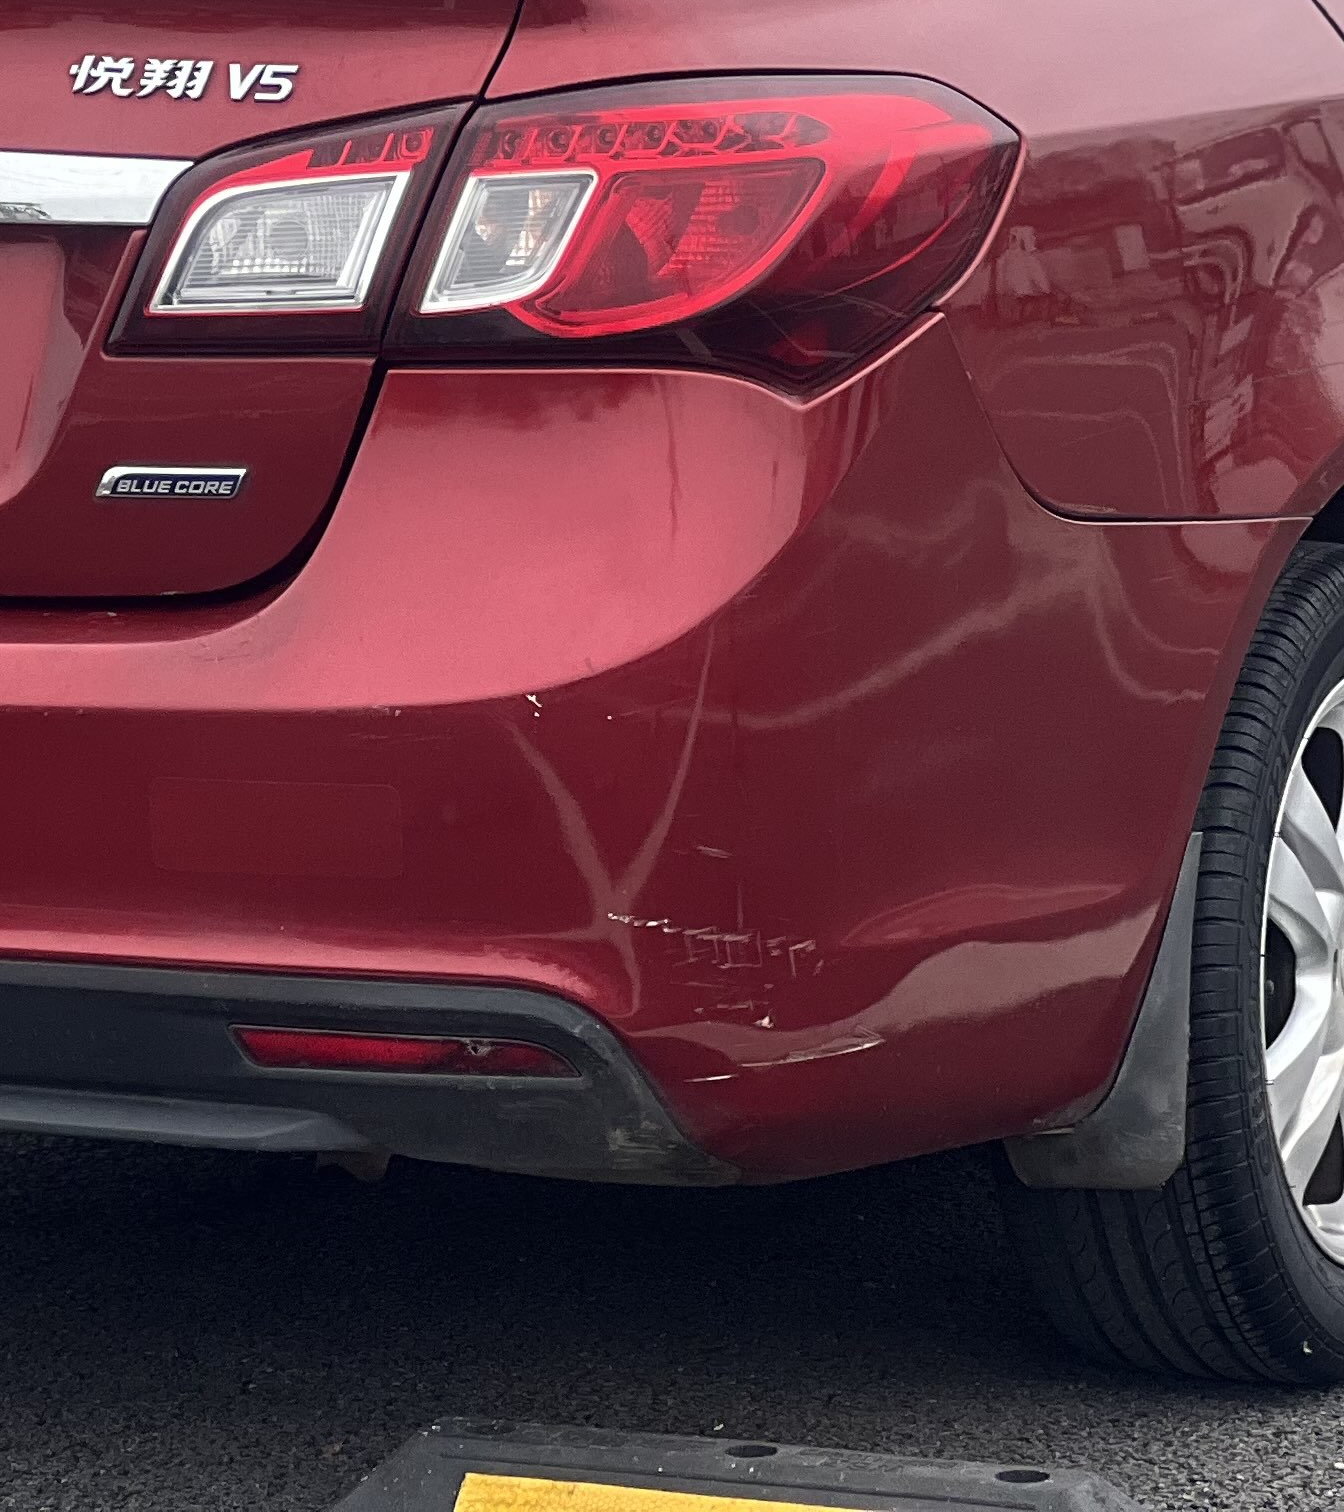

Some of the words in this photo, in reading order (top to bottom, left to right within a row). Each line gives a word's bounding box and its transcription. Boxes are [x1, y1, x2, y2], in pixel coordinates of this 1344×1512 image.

[69, 54, 214, 100] 悦翔
[228, 63, 299, 102] V5
[115, 479, 173, 494] BLUE
[174, 480, 234, 495] CORE
